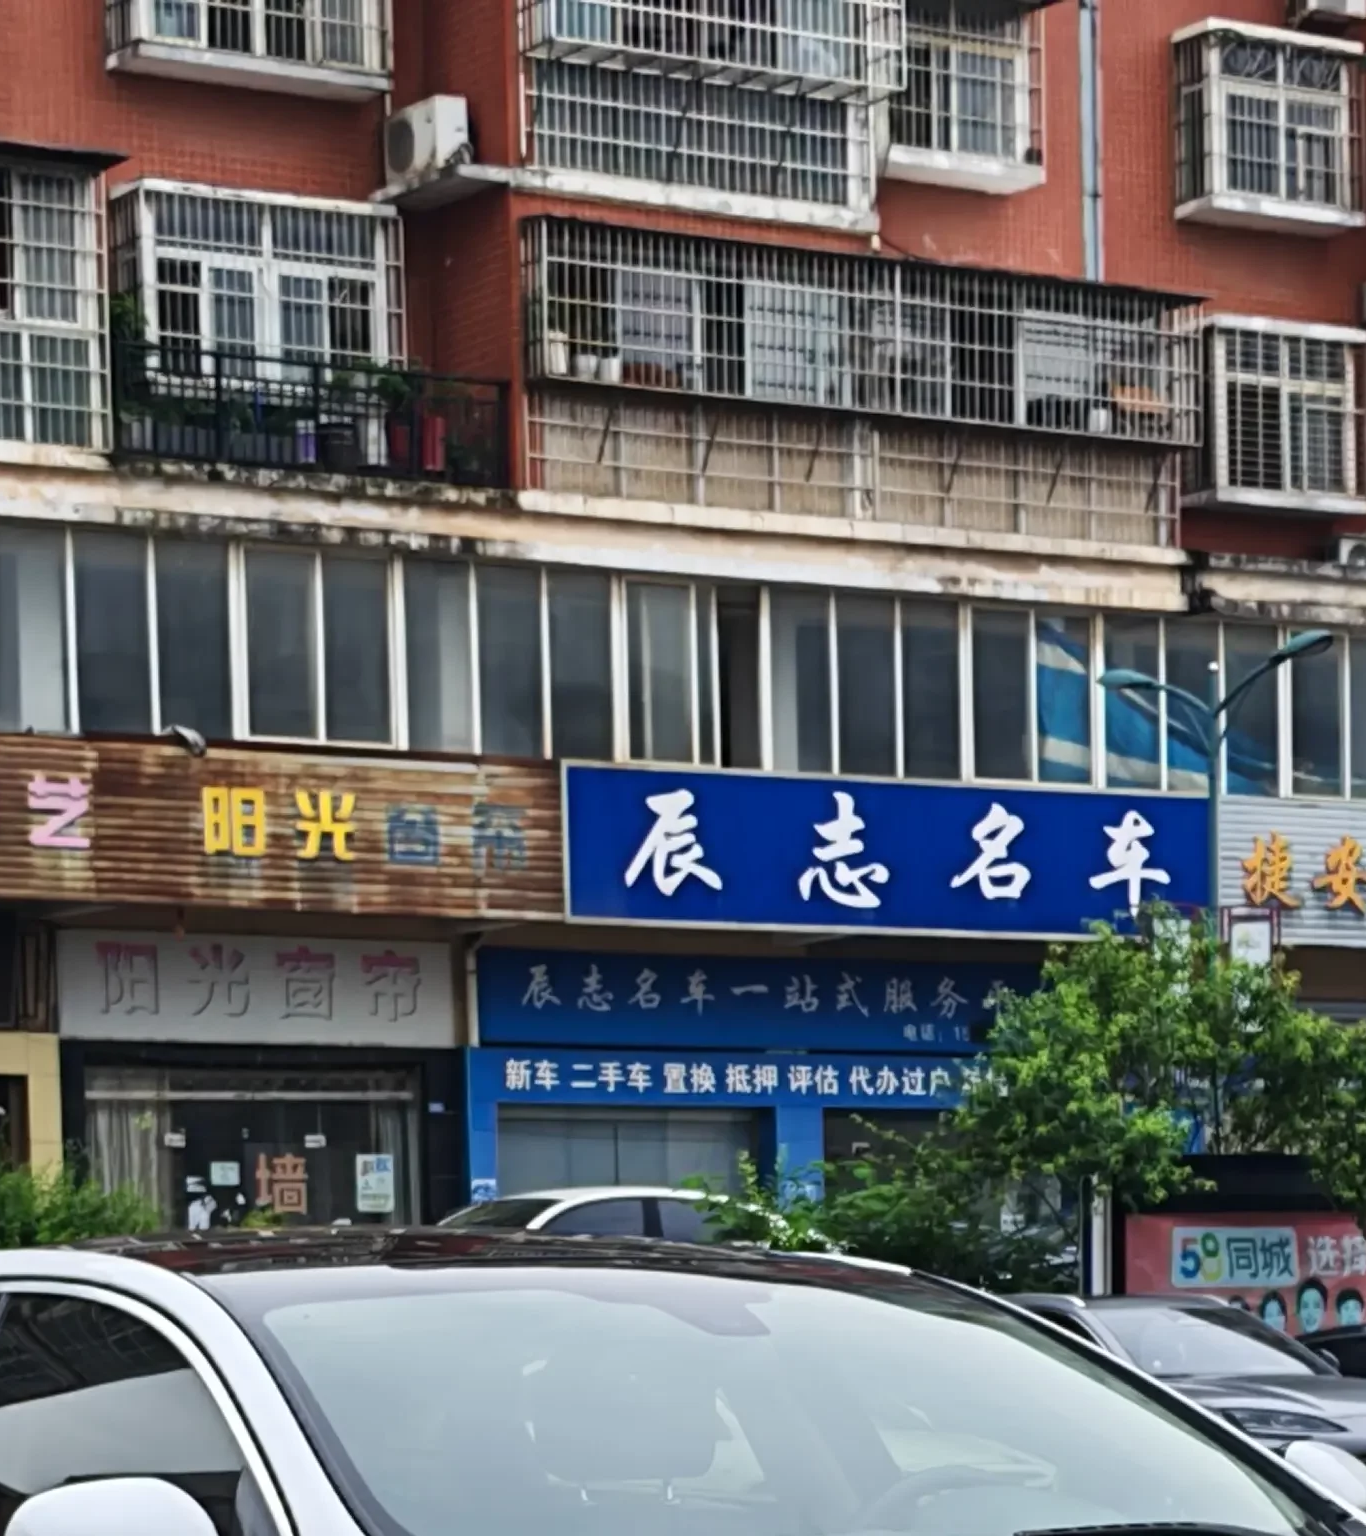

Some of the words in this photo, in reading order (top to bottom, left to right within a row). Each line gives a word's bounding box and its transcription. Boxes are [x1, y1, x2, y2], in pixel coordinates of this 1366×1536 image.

[624, 788, 1172, 917] 辰志名车
[95, 940, 423, 1022] 阳光窗帘
[505, 1059, 560, 1091] 新车
[571, 1061, 653, 1093] 二手车
[663, 1063, 717, 1094] 置换
[725, 1064, 779, 1096] 抵押
[787, 1065, 838, 1097] 评估
[849, 1066, 951, 1097] 代办过户
[256, 1152, 308, 1215] 墙
[1179, 1231, 1295, 1282] 58同城
